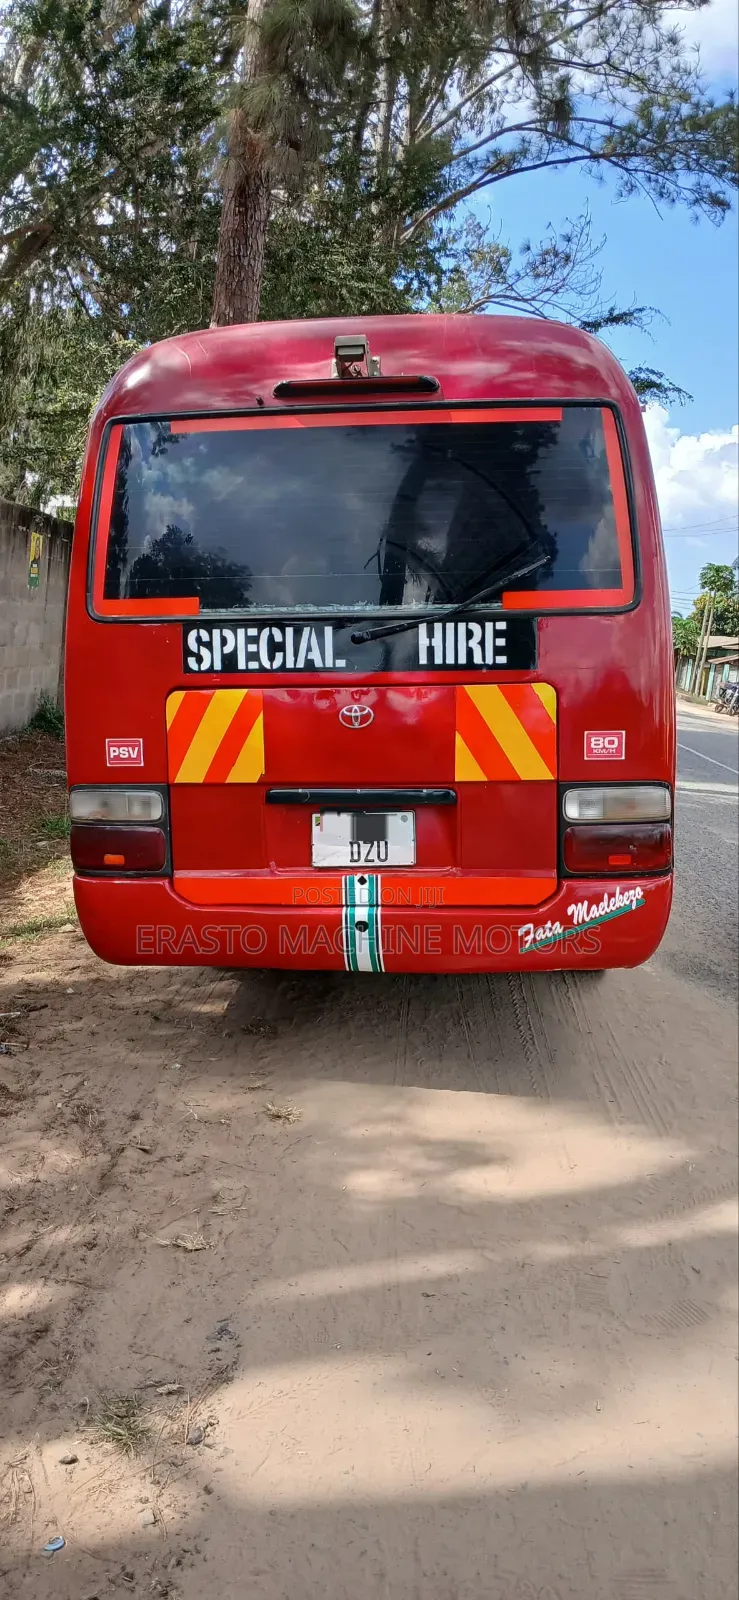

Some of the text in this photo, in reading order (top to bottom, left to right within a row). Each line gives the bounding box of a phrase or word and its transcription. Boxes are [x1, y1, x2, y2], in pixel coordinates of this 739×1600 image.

[187, 621, 508, 672] SPECIAL HIRE
[109, 747, 139, 759] PSV
[590, 737, 619, 749] 80
[348, 840, 389, 863] DZU
[518, 886, 644, 949] Fata Maelekezo
